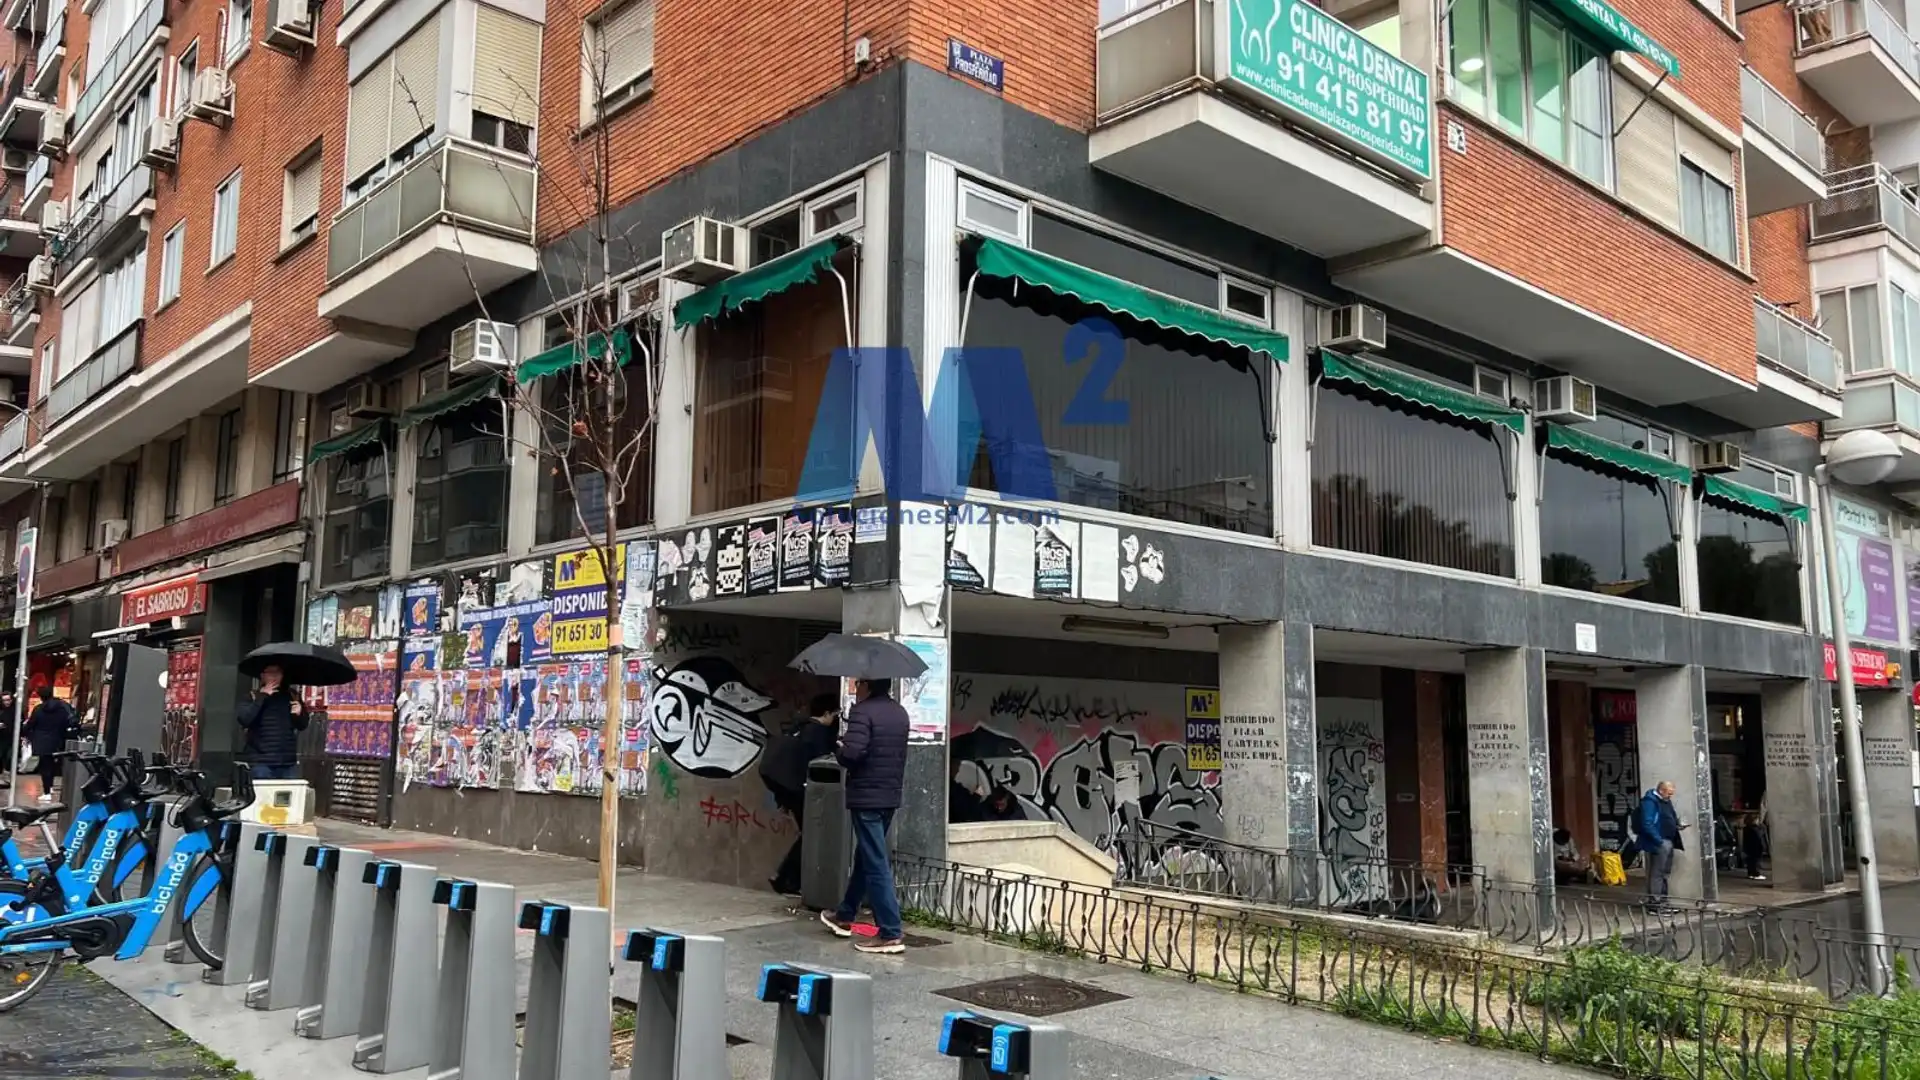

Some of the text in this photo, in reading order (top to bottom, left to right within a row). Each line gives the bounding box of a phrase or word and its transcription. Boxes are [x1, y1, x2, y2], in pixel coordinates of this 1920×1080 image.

[1290, 2, 1424, 104] CLINICA DENTAL
[954, 57, 998, 85] PROSPERIDAD
[1292, 36, 1424, 123] PLAZA PROSPERIDAD
[1277, 51, 1305, 89] 91
[1316, 76, 1359, 117] 415
[1366, 101, 1391, 134] 81
[1400, 119, 1425, 150] 97
[1235, 62, 1424, 168] www.clinicadentalplazaprosperidad.com
[788, 537, 808, 550] NOS
[827, 537, 846, 550] NOS
[136, 586, 188, 618] EL SABROSO
[556, 625, 567, 643] 91
[569, 624, 586, 641] 651
[590, 623, 602, 640] 30
[1224, 715, 1275, 724] PROHIBIDO
[1233, 728, 1265, 736] FIJAR
[1191, 746, 1202, 761] 91
[1227, 739, 1279, 749] CARTELES
[1224, 751, 1283, 761] RESP. EMPR.
[151, 851, 188, 914] bicimad
